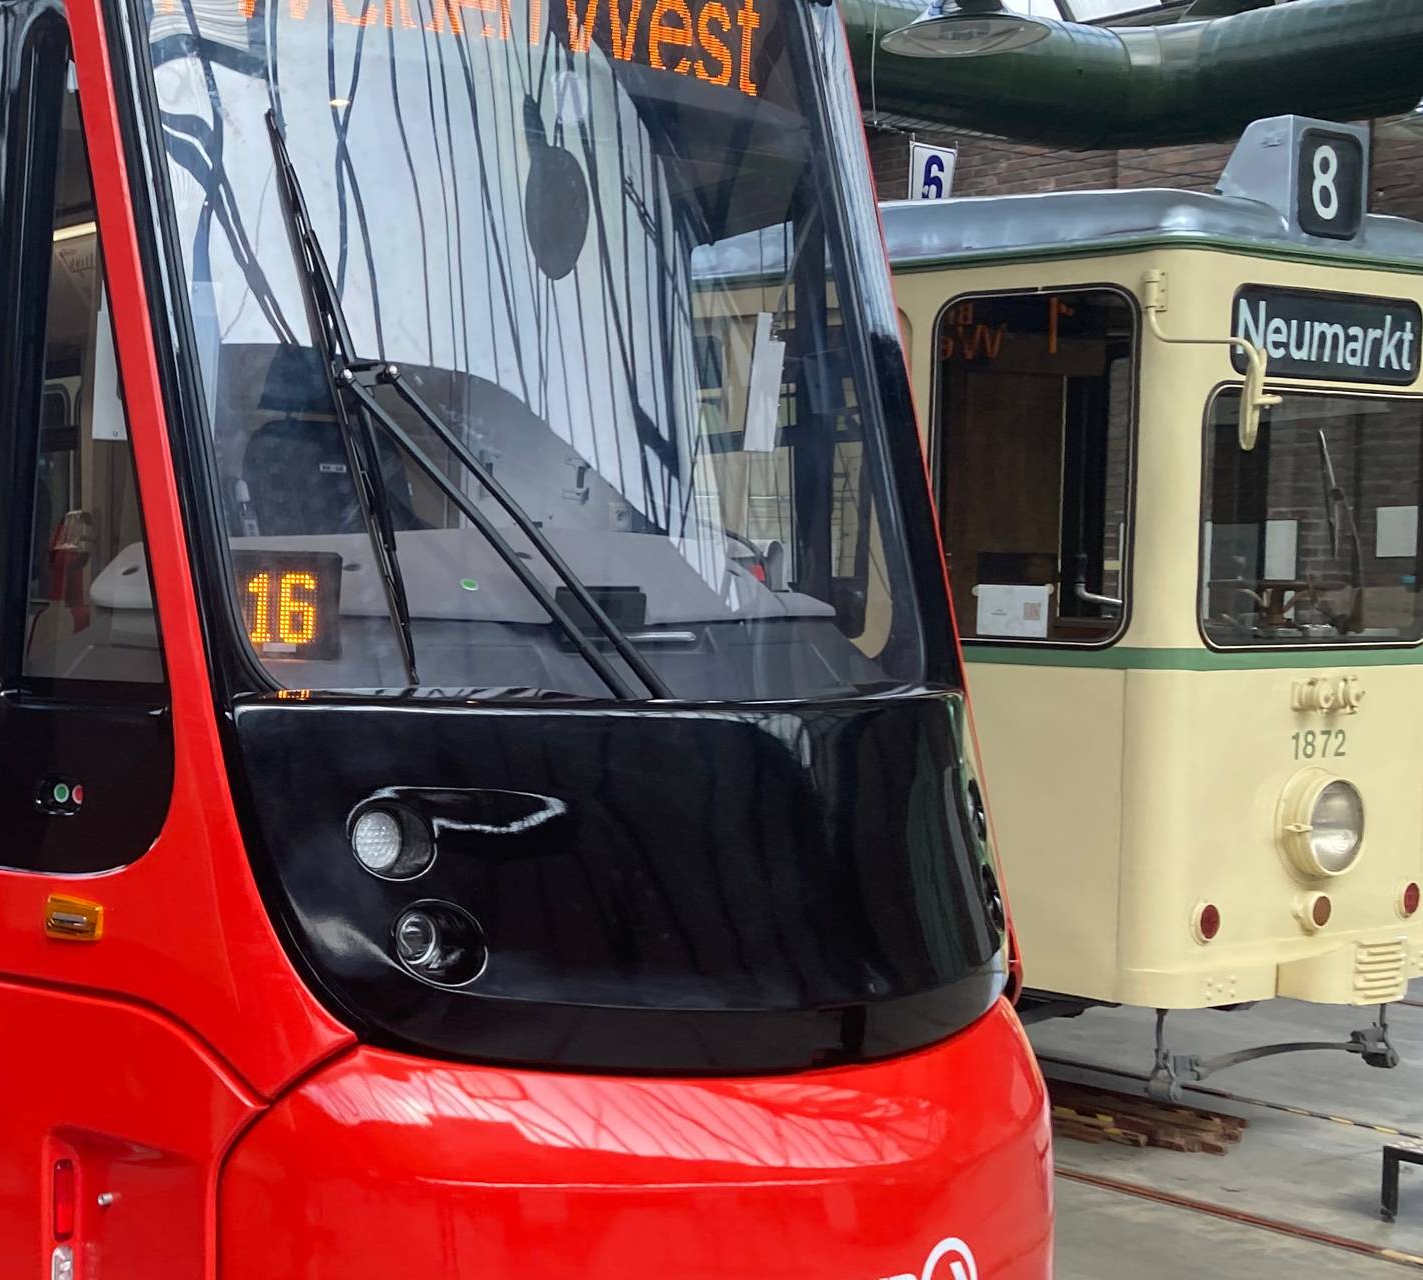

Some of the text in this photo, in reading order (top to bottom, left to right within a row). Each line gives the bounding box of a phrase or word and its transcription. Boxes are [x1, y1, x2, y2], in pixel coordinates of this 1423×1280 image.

[921, 154, 945, 199] 6
[1312, 145, 1338, 220] 8
[1235, 298, 1414, 371] Neumarkt
[248, 573, 316, 643] 16
[1291, 728, 1347, 761] 1872
